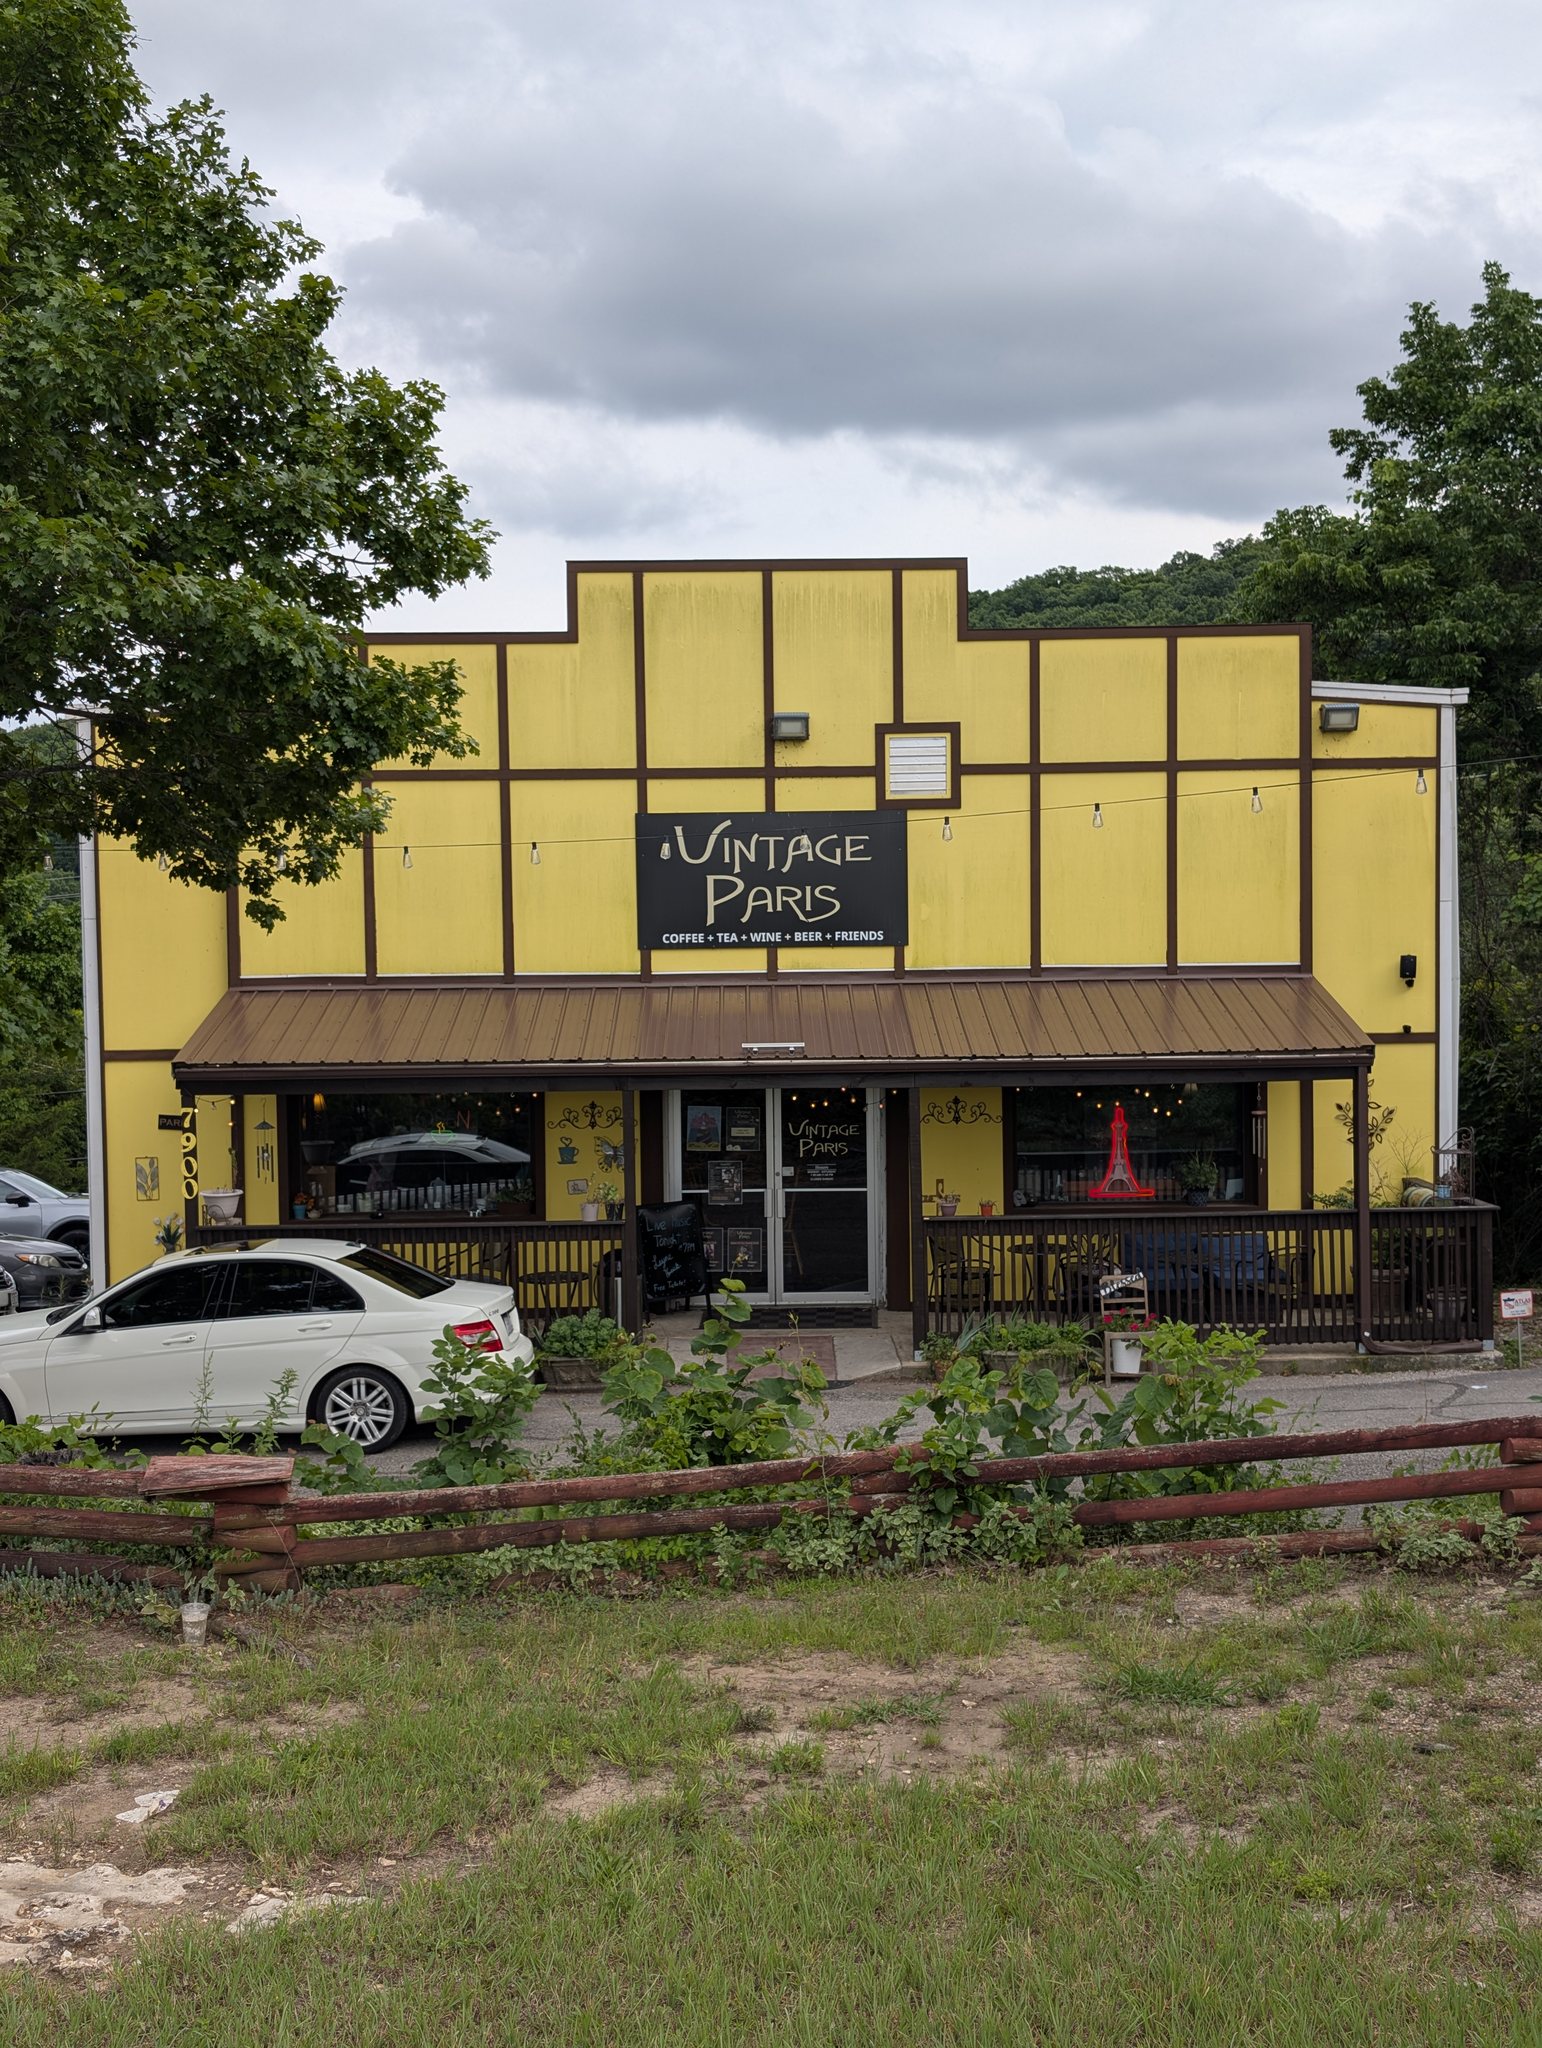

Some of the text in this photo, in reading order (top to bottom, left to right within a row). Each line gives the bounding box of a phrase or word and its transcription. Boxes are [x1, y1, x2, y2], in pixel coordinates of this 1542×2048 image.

[674, 819, 872, 874] VINTAGE
[706, 874, 841, 927] PARIS
[662, 933, 705, 944] COFFEE
[716, 933, 739, 943] TEA
[750, 932, 782, 943] WINE
[794, 932, 823, 942] BEER
[834, 931, 884, 942] FRIENDS
[788, 1119, 860, 1139] VINTAGE
[180, 1107, 199, 1199] 7900
[800, 1139, 848, 1158] PARIS
